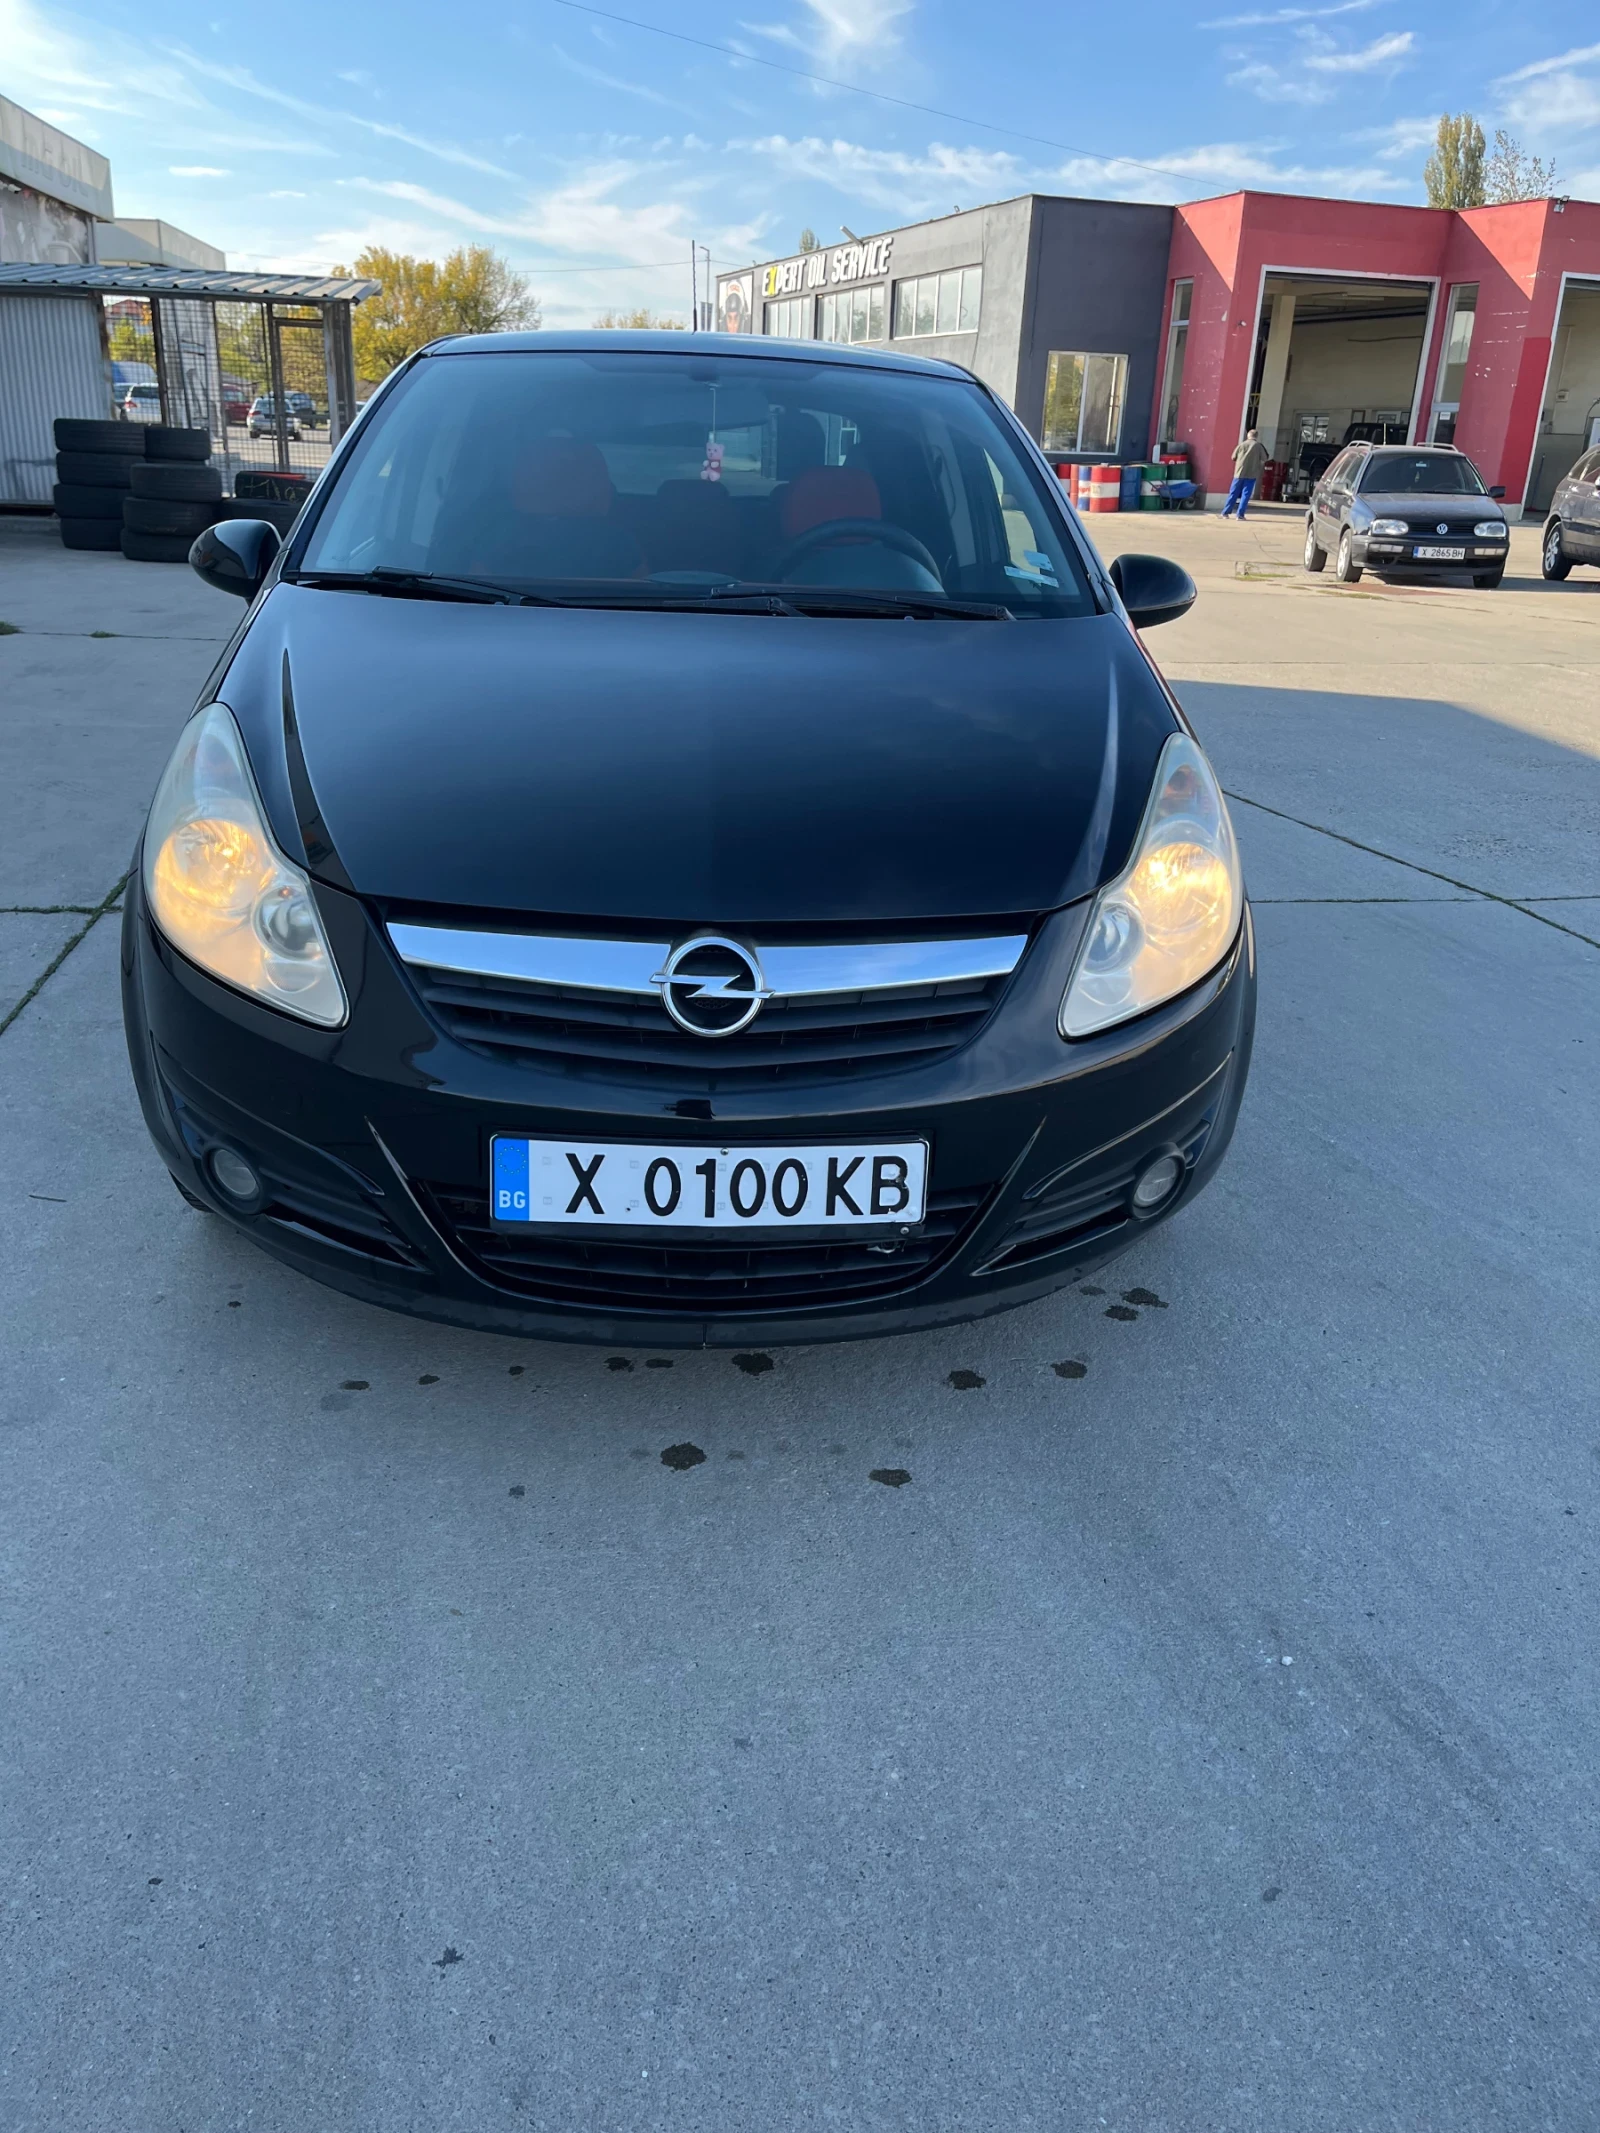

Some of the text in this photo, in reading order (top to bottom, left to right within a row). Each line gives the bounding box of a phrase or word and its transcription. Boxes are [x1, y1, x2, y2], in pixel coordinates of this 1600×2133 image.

[762, 237, 893, 297] EXPERT OIL SERVICE
[498, 1189, 527, 1209] BG
[564, 1152, 606, 1215] X
